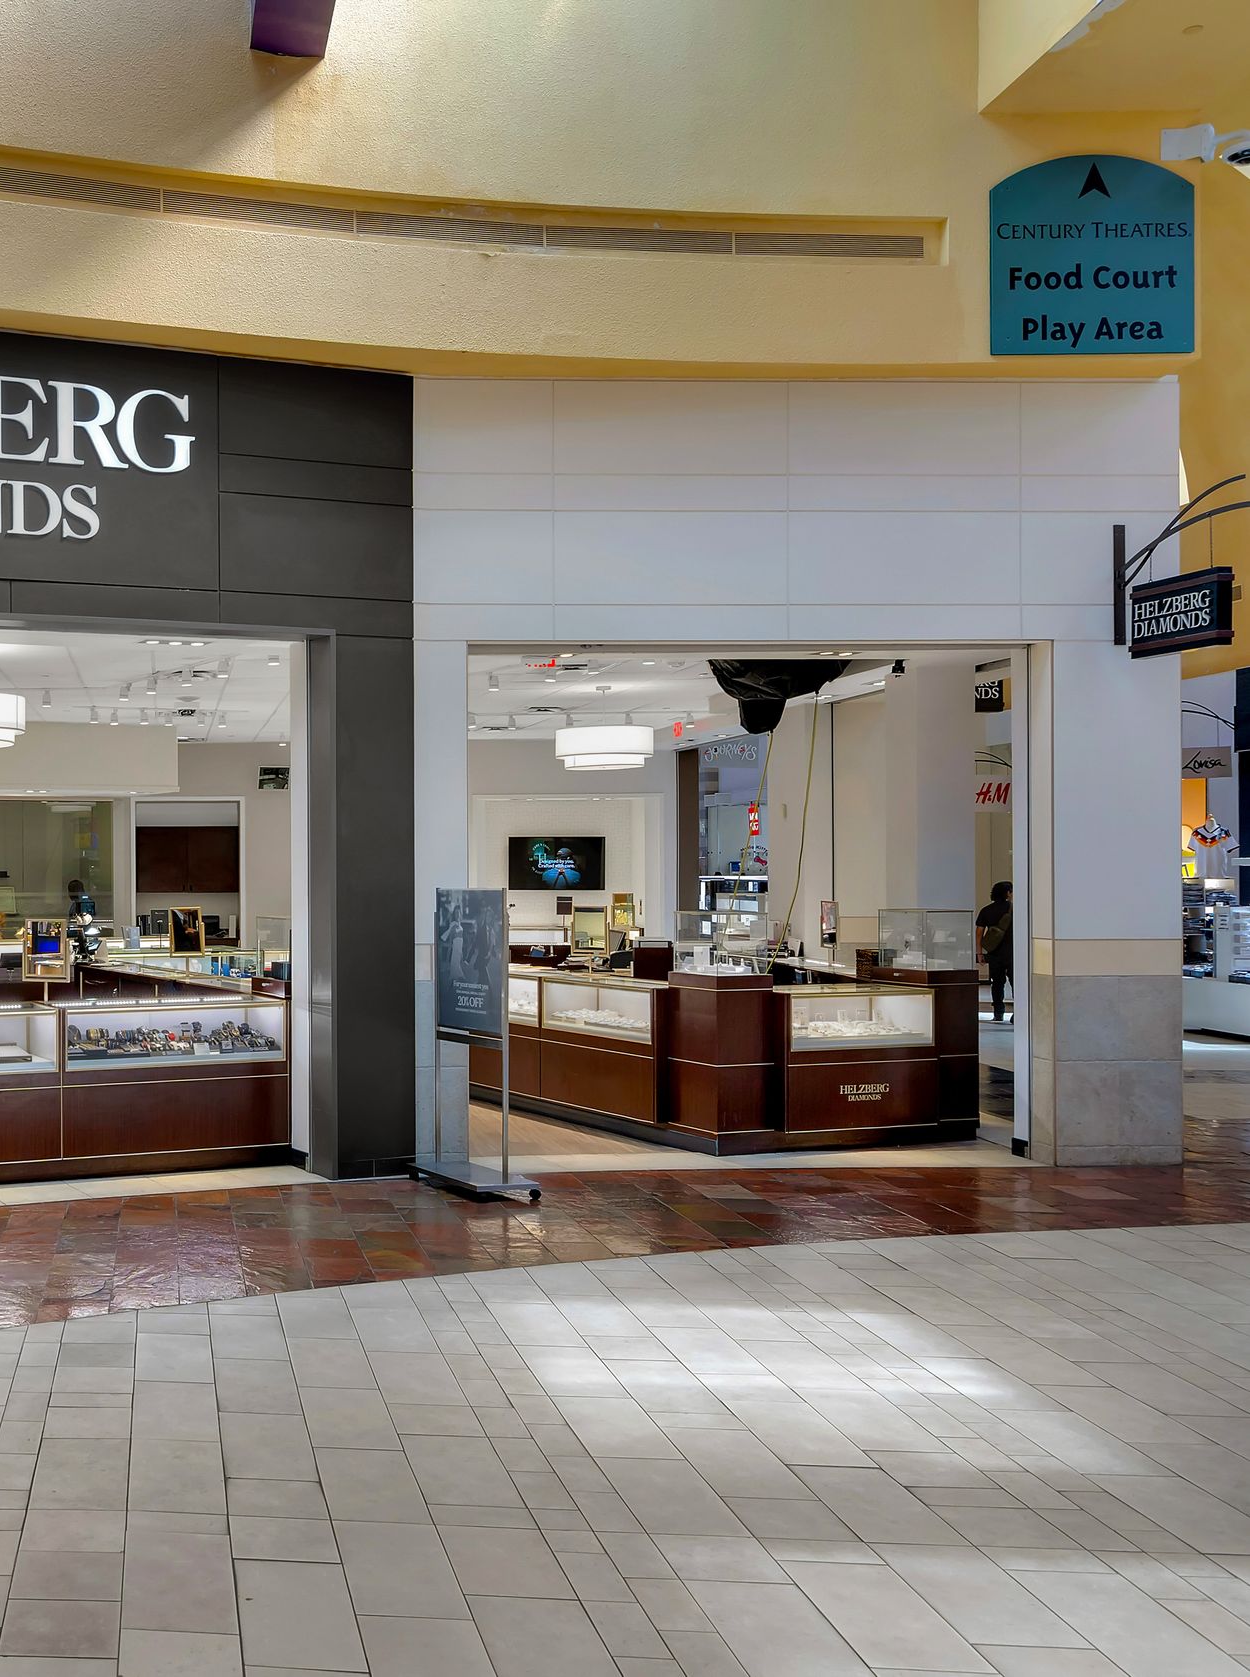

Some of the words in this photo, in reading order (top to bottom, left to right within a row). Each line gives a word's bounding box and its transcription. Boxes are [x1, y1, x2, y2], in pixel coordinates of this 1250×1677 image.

[996, 222, 1086, 240] CENTURY
[1091, 221, 1189, 239] THEATRES
[1009, 262, 1083, 290] Food
[1092, 265, 1178, 290] Court
[1022, 314, 1086, 349] Play
[1094, 316, 1164, 341] Area
[1133, 589, 1211, 620] HELZBERG
[1133, 608, 1211, 639] DIAMONDS
[1182, 751, 1227, 773] Lovisa
[975, 782, 1011, 805] H&M
[839, 1083, 890, 1094] HELZBERG
